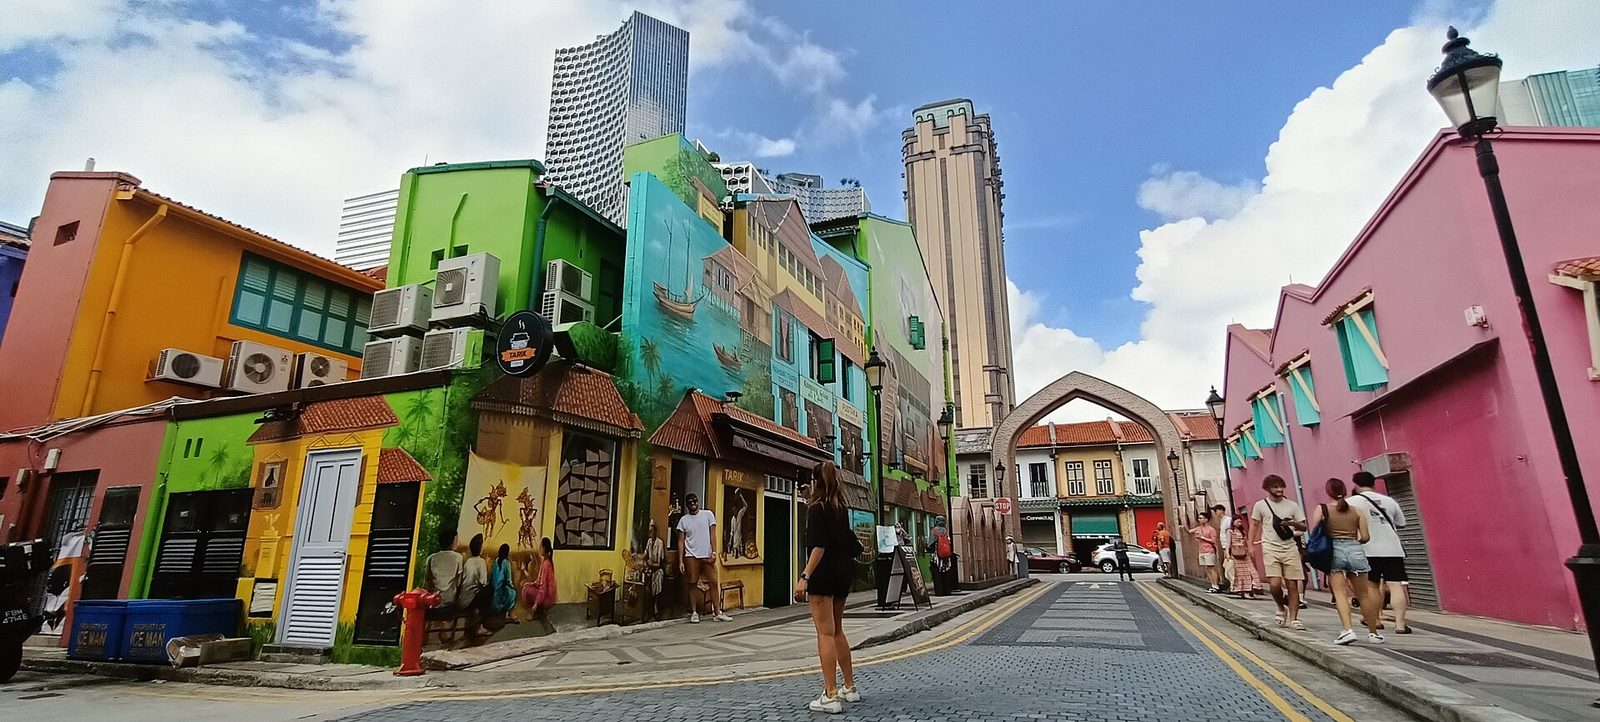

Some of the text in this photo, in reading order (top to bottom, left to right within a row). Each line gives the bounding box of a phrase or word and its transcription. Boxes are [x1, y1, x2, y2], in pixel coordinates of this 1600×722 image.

[509, 351, 527, 359] TARIK
[724, 469, 745, 483] TARIK
[995, 502, 1010, 510] STOP
[4, 608, 23, 617] FBM
[88, 630, 108, 647] MAN
[130, 631, 166, 647] ICE MAN
